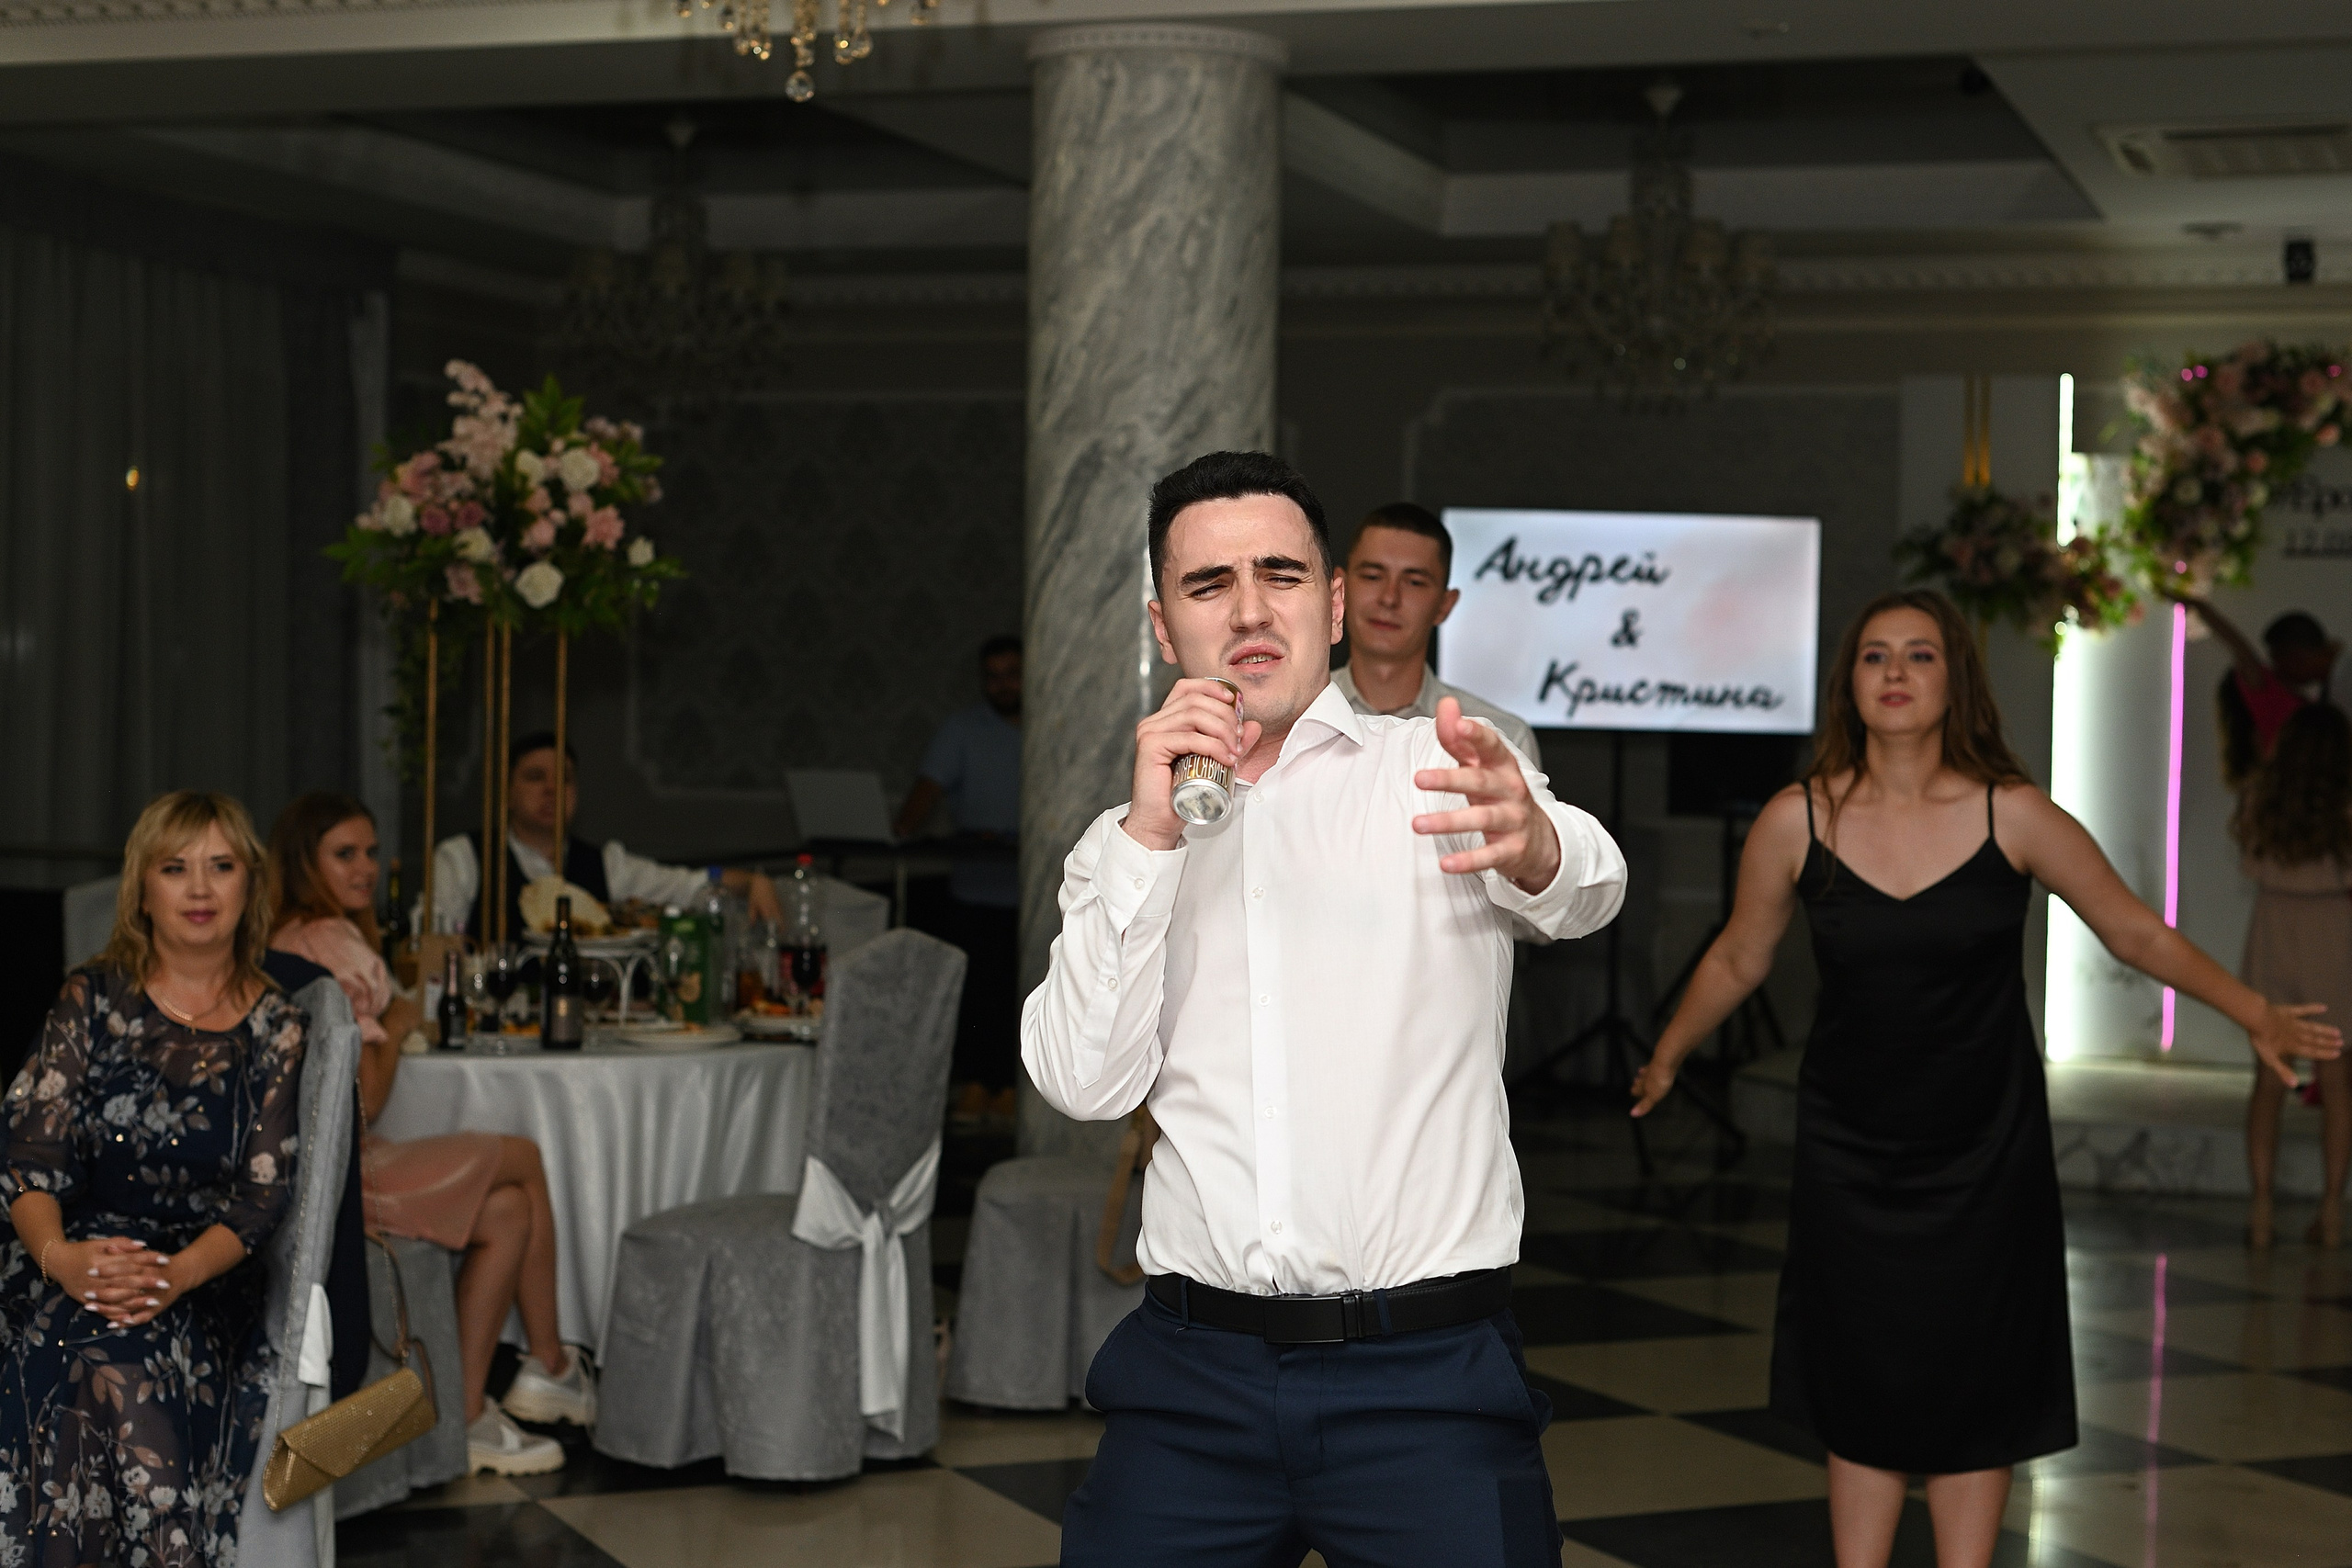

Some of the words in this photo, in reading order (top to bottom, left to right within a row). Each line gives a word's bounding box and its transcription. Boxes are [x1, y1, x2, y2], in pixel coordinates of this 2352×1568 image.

[1474, 536, 1669, 604] Андрей
[1610, 609, 1641, 648] &
[1537, 659, 1784, 717] Кристина
